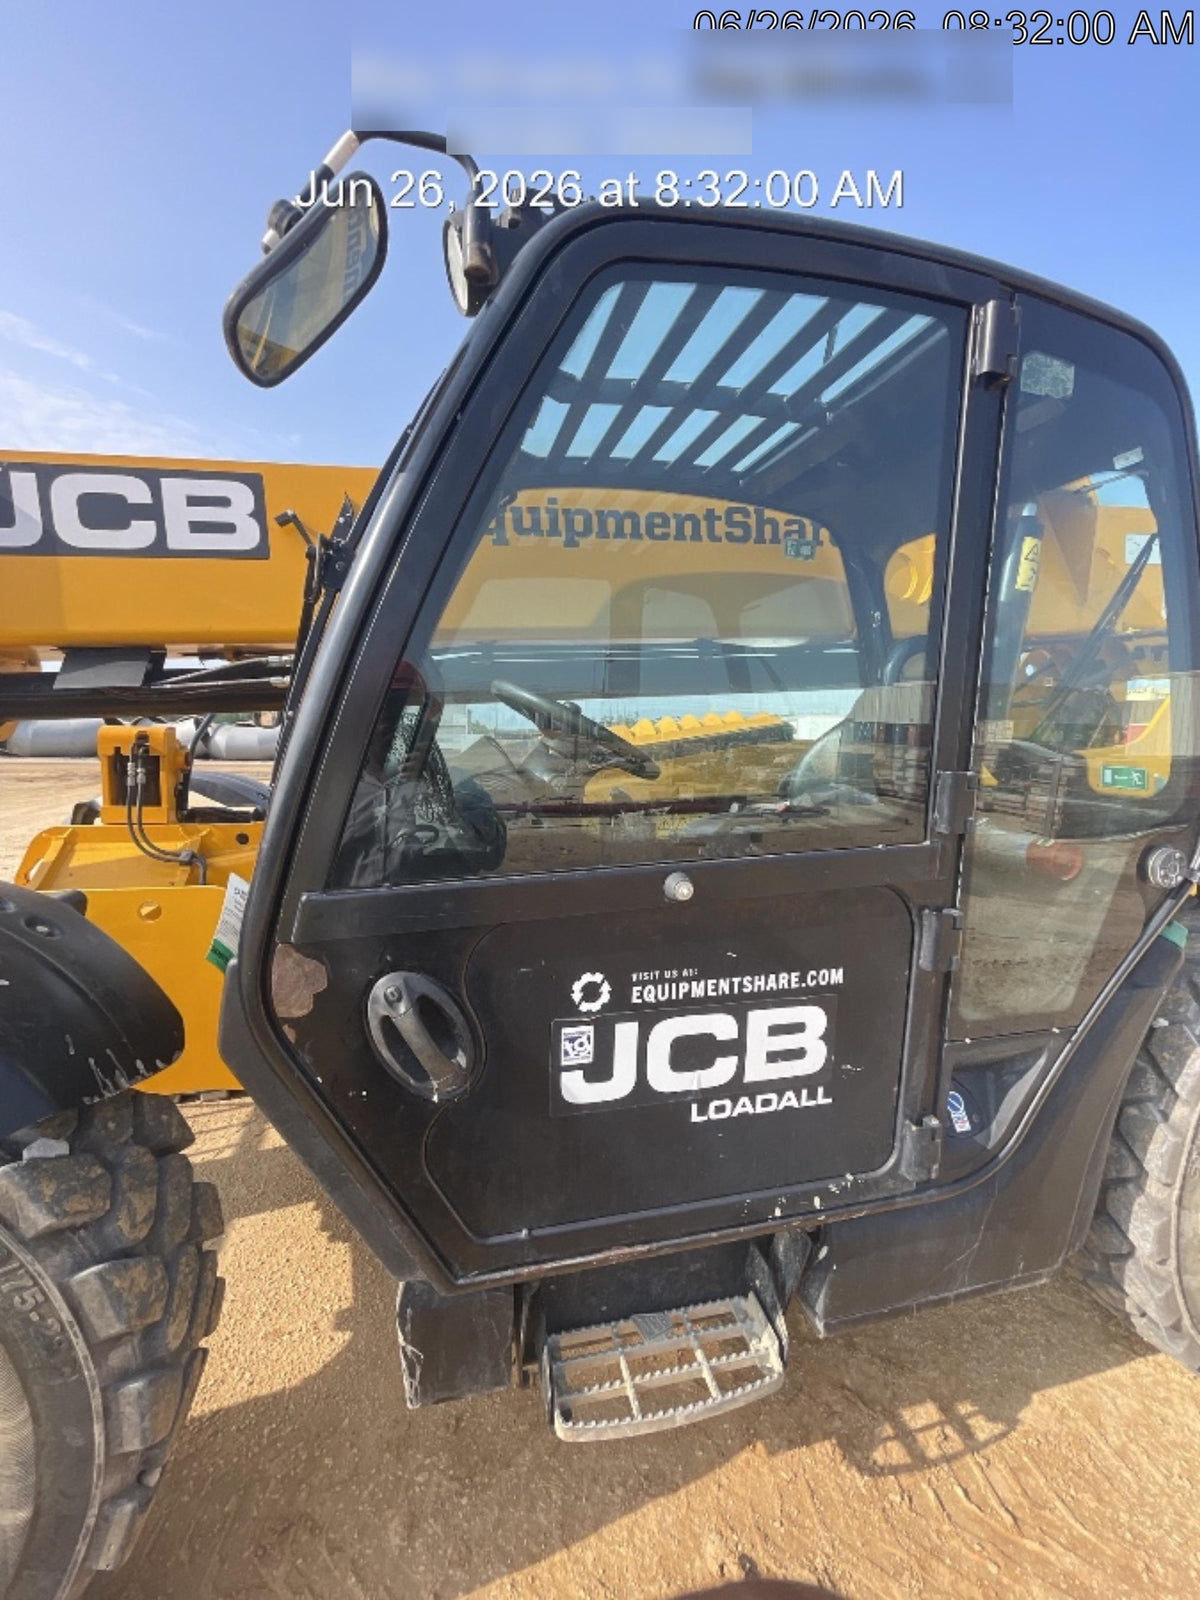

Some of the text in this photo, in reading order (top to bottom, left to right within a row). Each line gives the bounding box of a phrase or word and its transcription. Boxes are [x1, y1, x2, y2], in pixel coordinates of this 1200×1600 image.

[0, 471, 261, 550] JCB
[631, 968, 844, 1004] EQUIPMENTSHARE.COM
[664, 969, 678, 979] US
[560, 1006, 828, 1105] JCB
[690, 1086, 833, 1122] LOADALL
